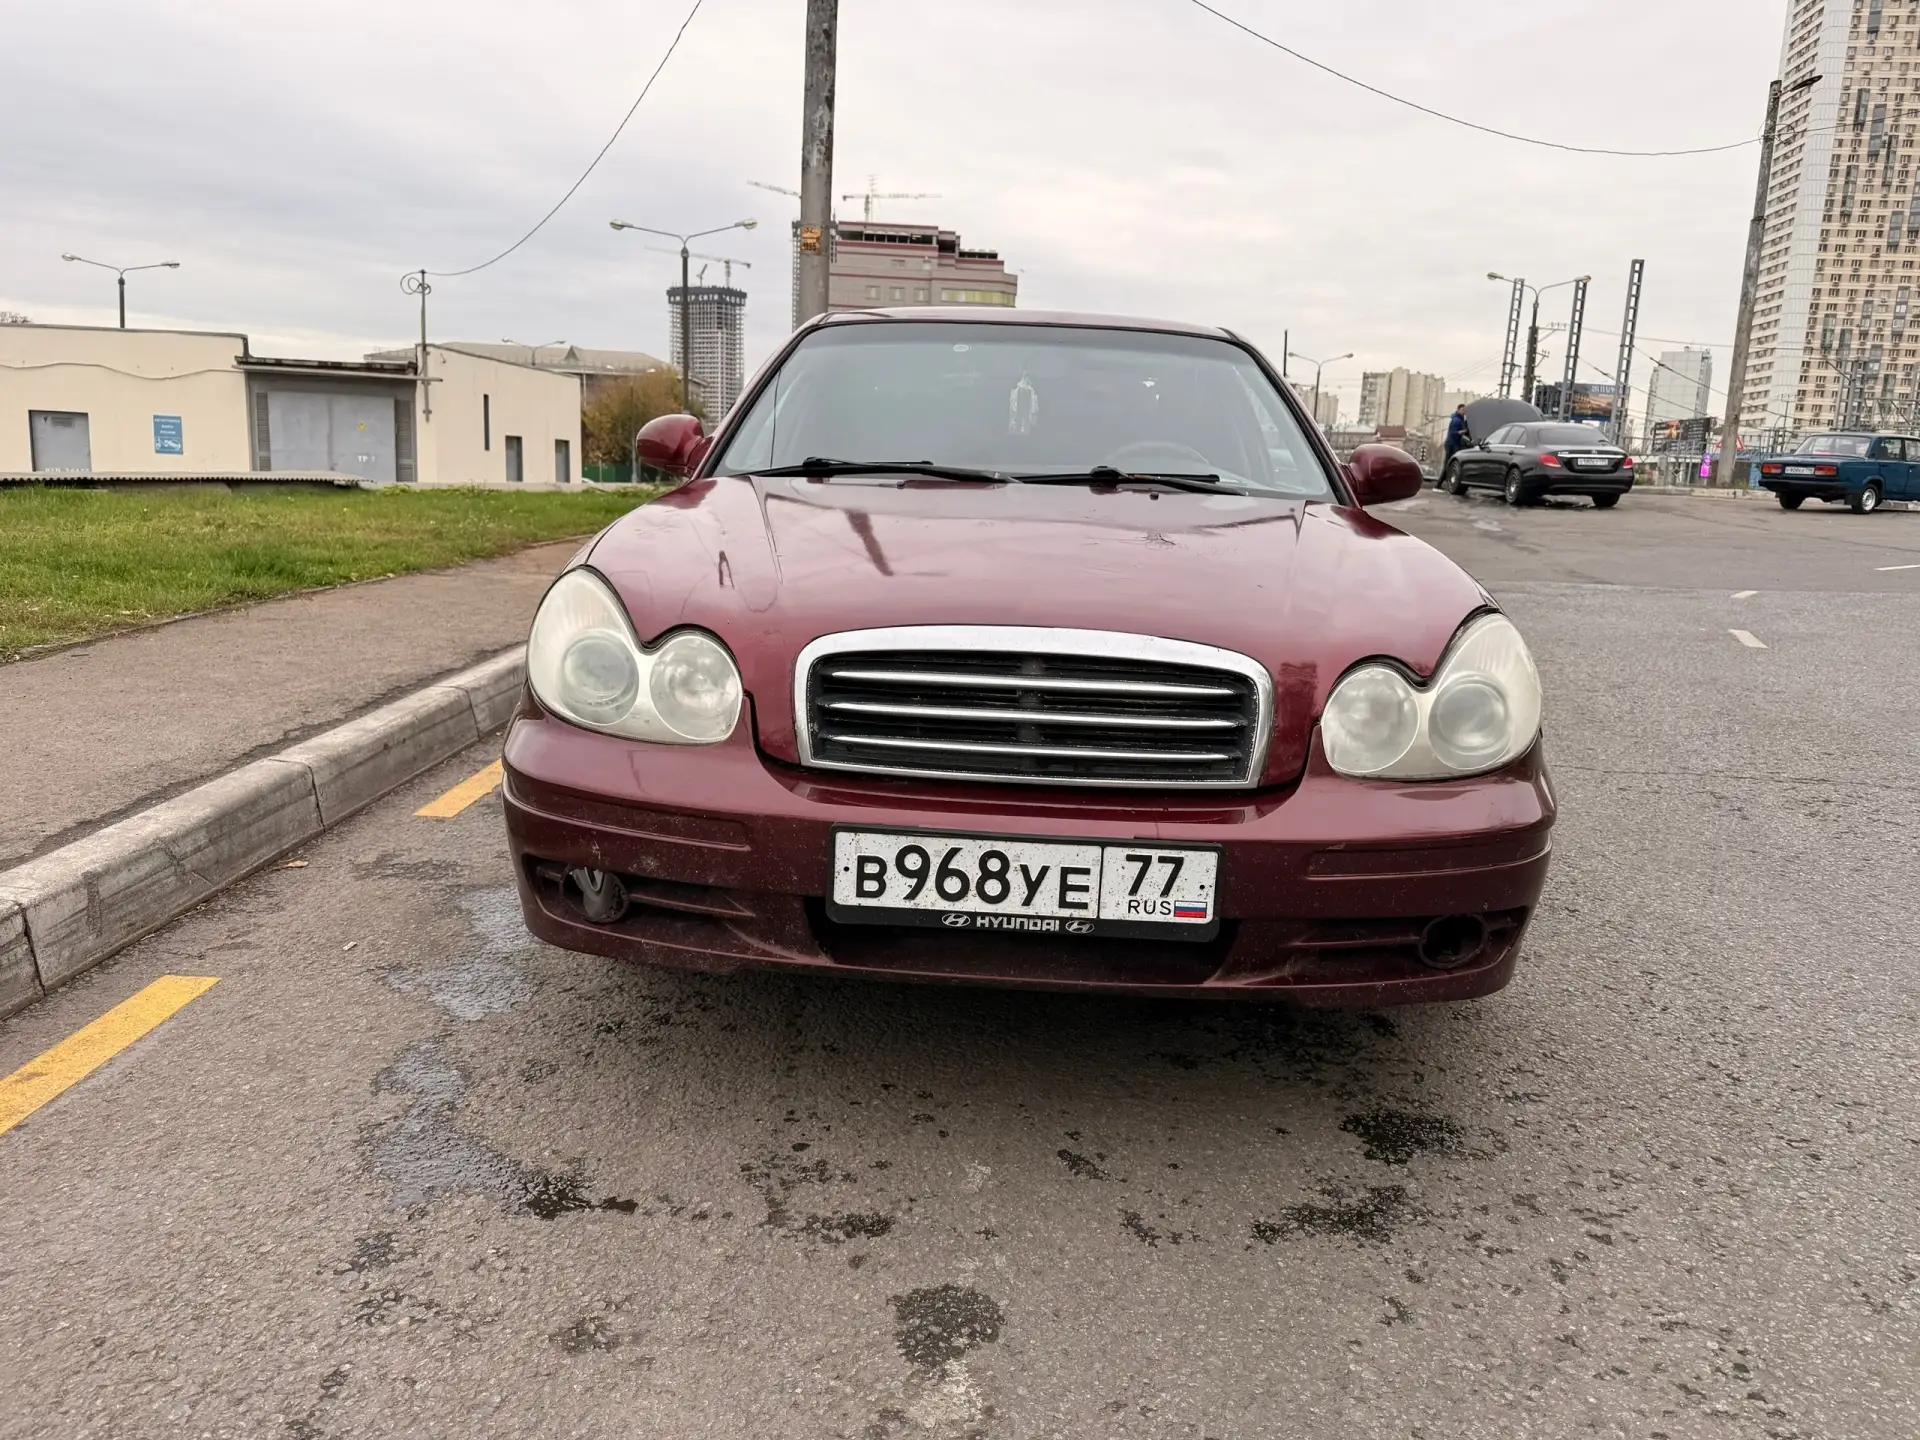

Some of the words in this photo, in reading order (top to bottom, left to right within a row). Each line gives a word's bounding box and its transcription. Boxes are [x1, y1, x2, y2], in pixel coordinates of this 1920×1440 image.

[1125, 853, 1186, 898] 77
[1127, 899, 1172, 916] RUS
[976, 915, 1060, 932] HYUNDAI
